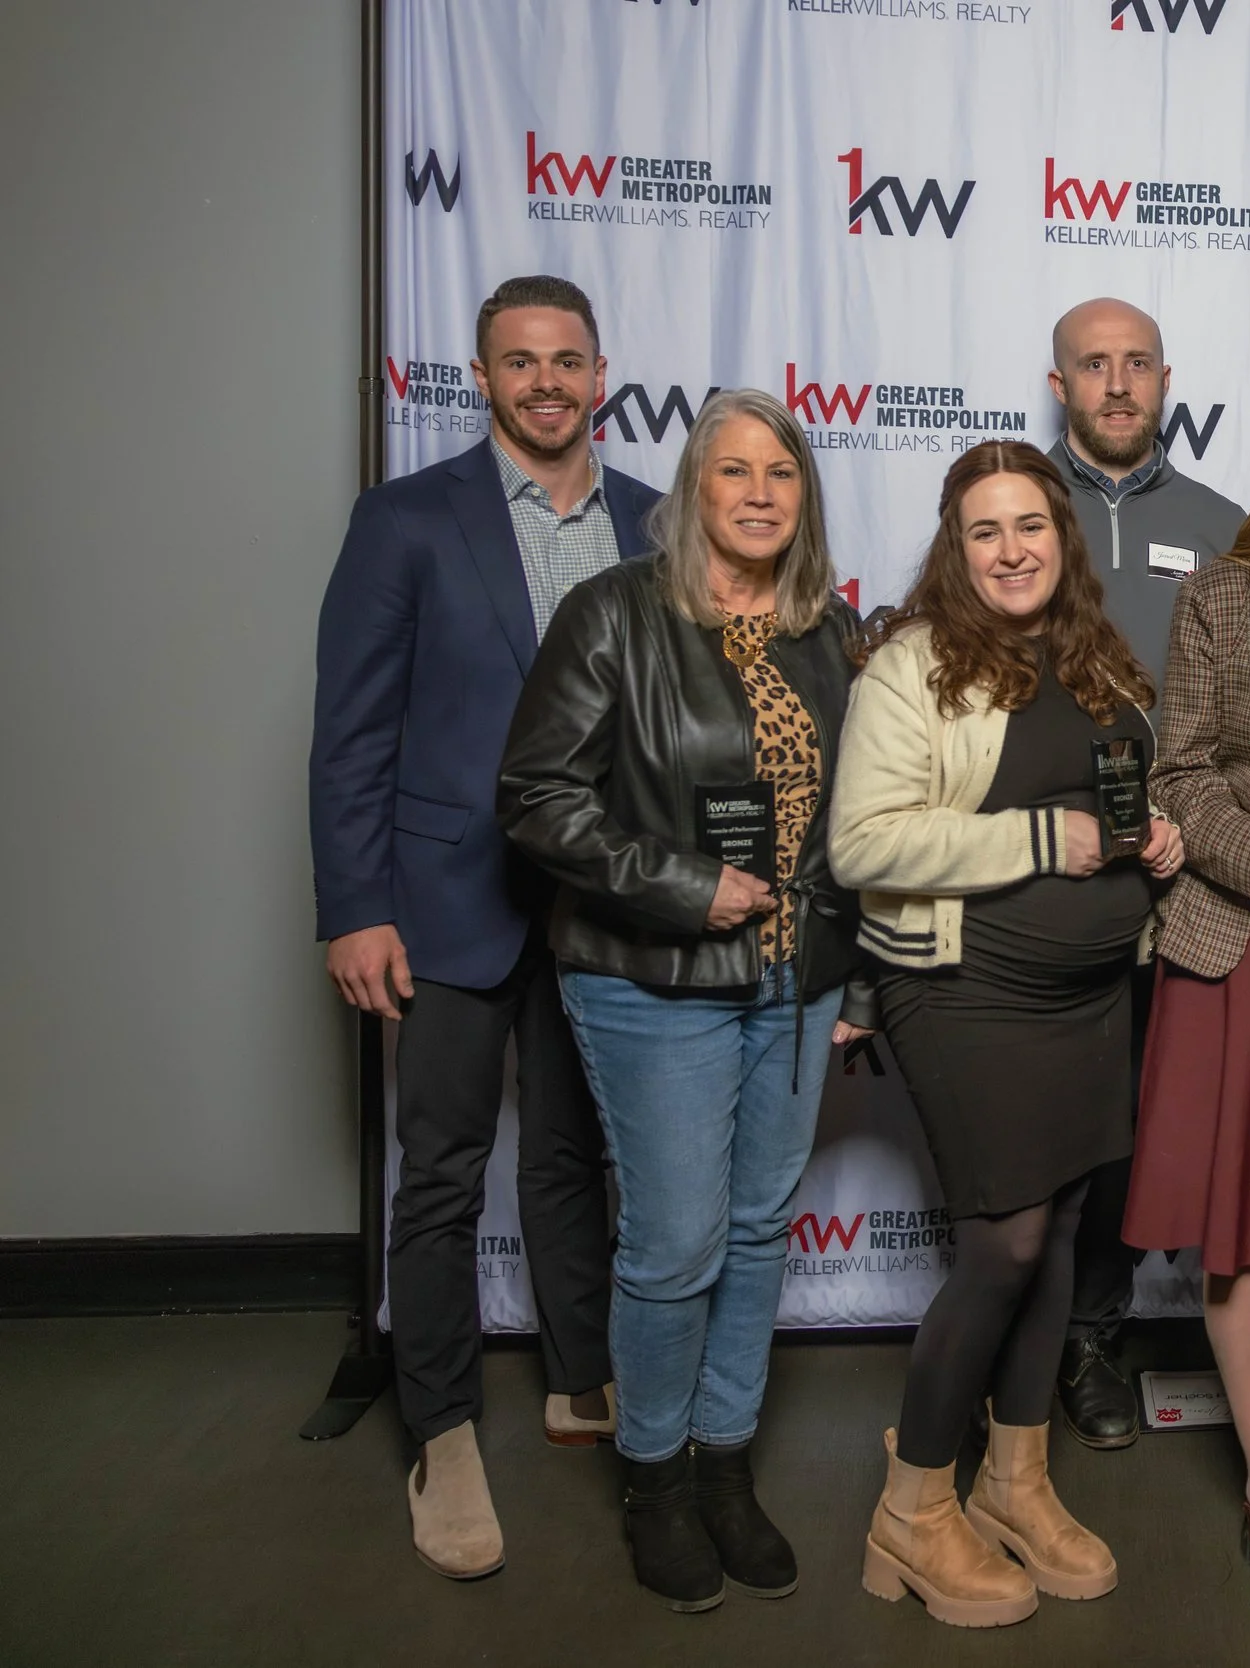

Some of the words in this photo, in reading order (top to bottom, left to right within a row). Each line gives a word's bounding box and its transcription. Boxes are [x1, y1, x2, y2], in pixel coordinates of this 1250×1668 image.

[957, 3, 1032, 24] REALTY
[620, 156, 713, 182] GREATER
[621, 180, 772, 206] METROPOLITAN
[1135, 181, 1222, 205] GREATER
[699, 210, 771, 230] REALTY
[876, 384, 964, 407] GREATER
[877, 407, 1026, 431] METROPOLITAN
[721, 839, 753, 848] BRONZE
[869, 1208, 951, 1229] GREATER
